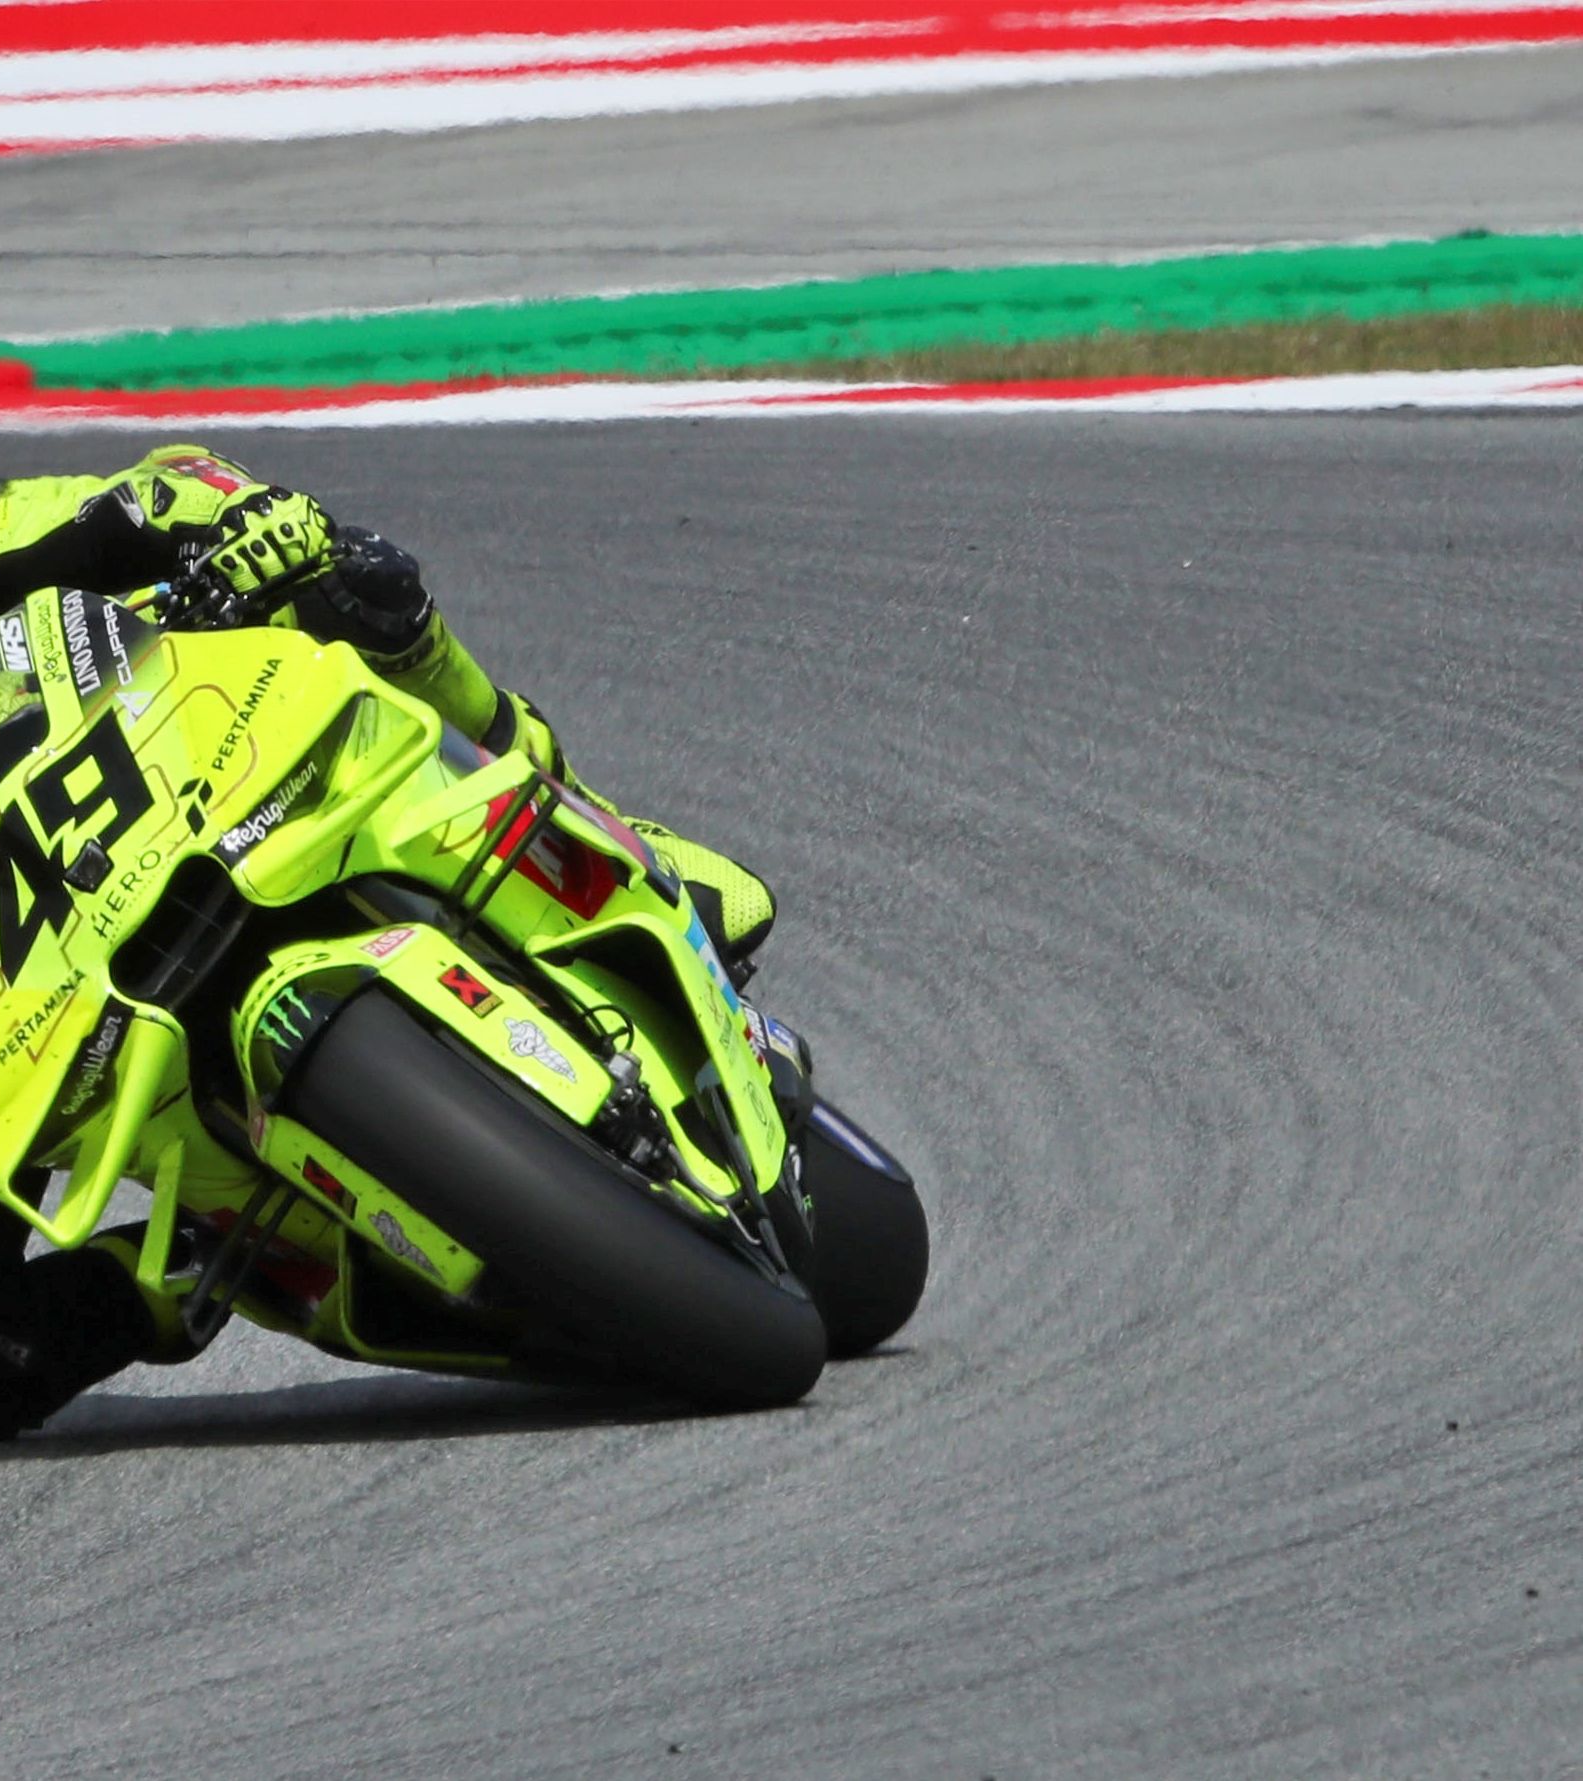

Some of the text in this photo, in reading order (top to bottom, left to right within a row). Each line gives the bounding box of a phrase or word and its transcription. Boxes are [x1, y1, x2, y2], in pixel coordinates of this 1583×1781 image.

[61, 589, 102, 697] LINO SONEGO
[103, 602, 133, 686] CUPRA
[212, 656, 284, 772] PERTAMINA
[220, 760, 319, 854] RefrigiWear
[94, 848, 162, 938] HERO
